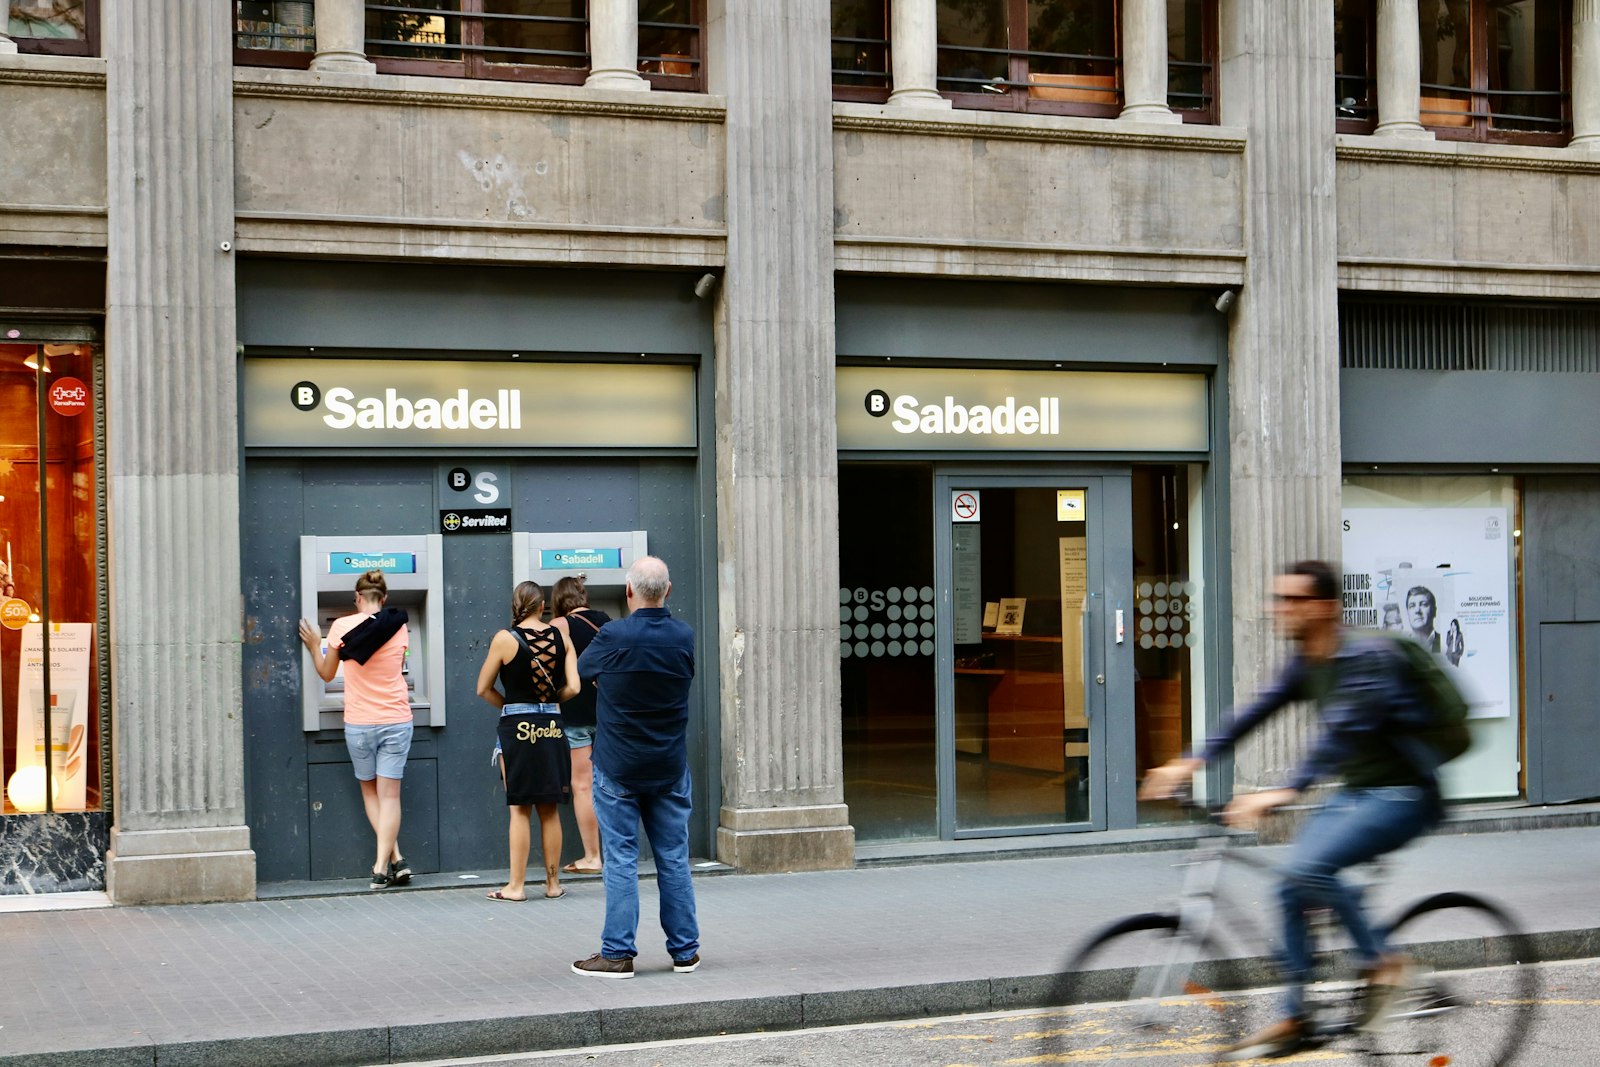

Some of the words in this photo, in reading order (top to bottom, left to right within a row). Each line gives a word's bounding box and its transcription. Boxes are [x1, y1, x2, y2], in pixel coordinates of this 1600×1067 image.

[322, 387, 522, 430] Sabadell
[891, 394, 1060, 435] Sabadell
[473, 471, 500, 504] S
[461, 514, 507, 527] ServiRed
[351, 557, 396, 569] Sabadell
[561, 553, 604, 565] Sabadell
[1343, 573, 1372, 591] FUTURS:
[869, 590, 886, 612] S
[1343, 592, 1358, 608] COM
[1359, 591, 1373, 608] HAN
[516, 720, 563, 744] Sjoeke
